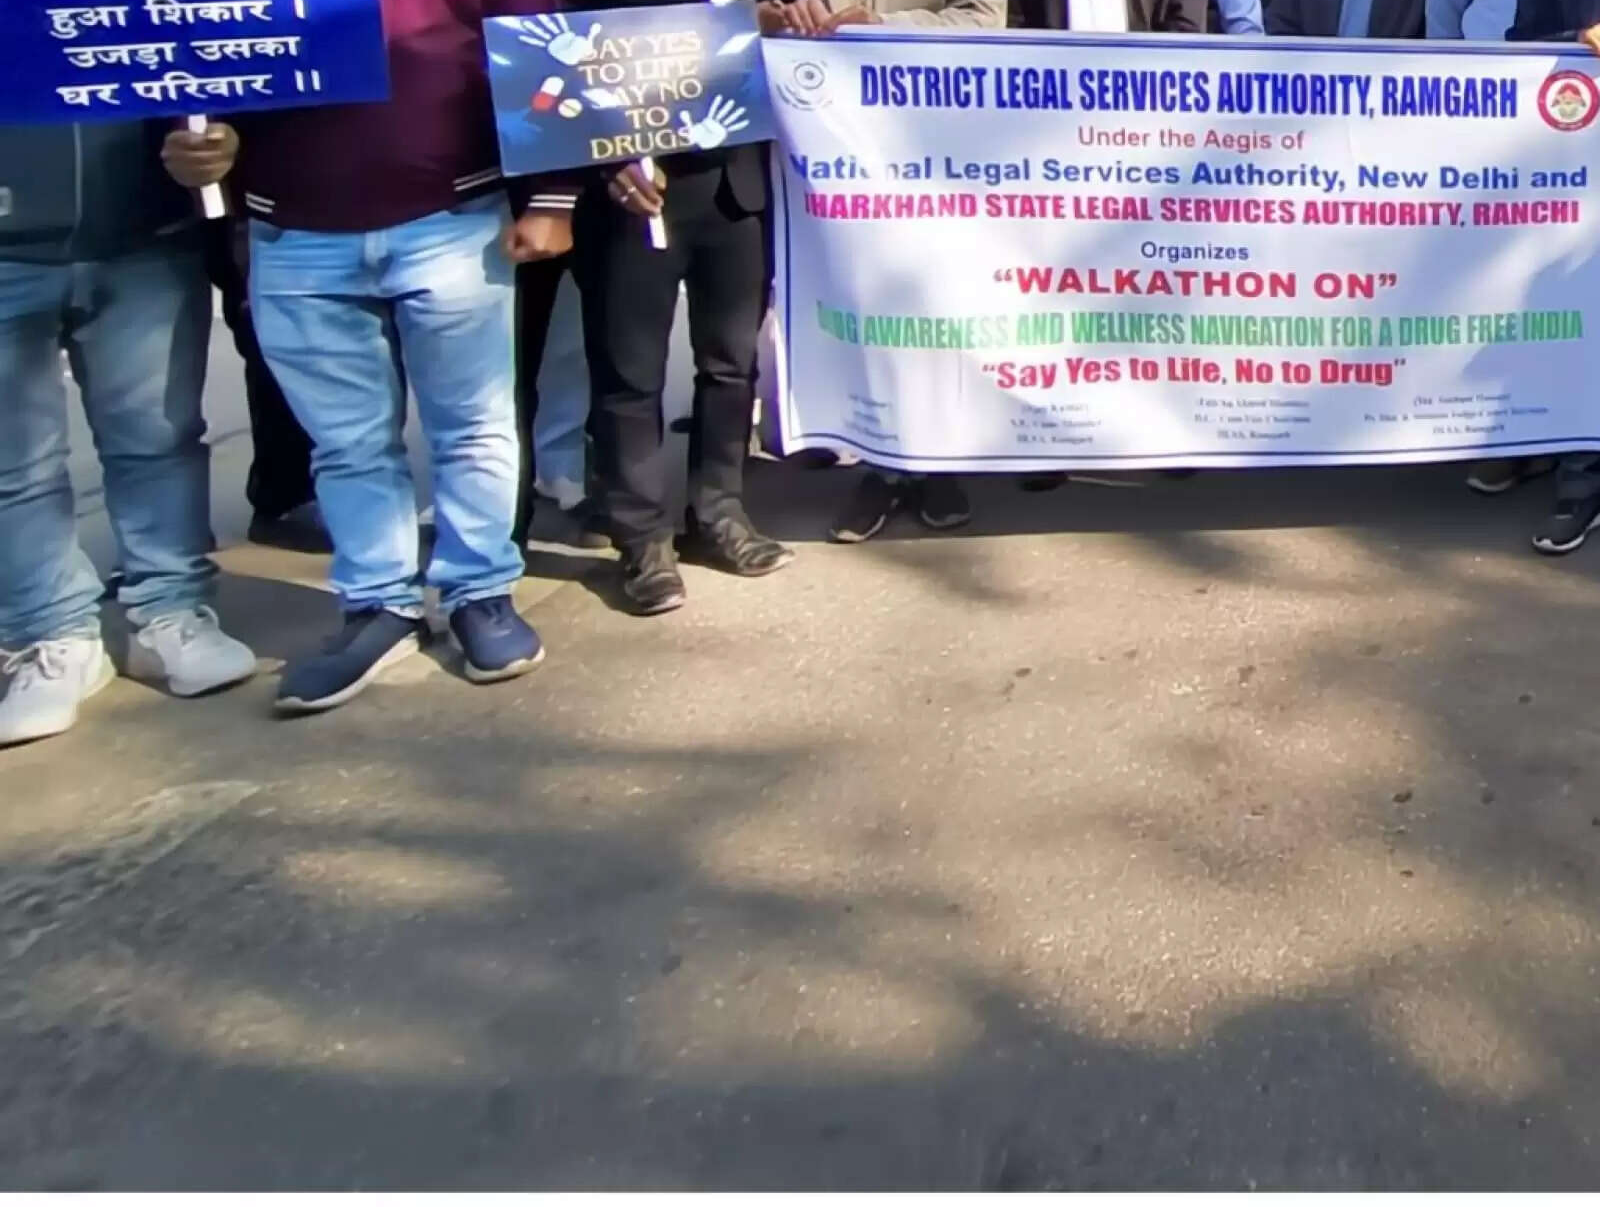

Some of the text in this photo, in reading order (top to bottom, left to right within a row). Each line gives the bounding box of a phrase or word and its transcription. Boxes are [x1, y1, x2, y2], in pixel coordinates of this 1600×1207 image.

[46, 6, 129, 39] हुआ
[63, 36, 301, 70] उजड़ा उसका
[645, 31, 700, 55] YES
[56, 83, 120, 106] घर
[131, 71, 273, 102] परिवार
[578, 62, 625, 85] TO
[660, 78, 702, 103] NO
[860, 65, 986, 109] DISTRICT
[995, 67, 1071, 110] LEGAL
[1080, 69, 1209, 113] SERVICES
[1217, 72, 1374, 119] AUTHORITY,
[1382, 75, 1517, 118] RAMGARH
[625, 106, 669, 129] TO
[590, 126, 696, 159] DRUGS
[1078, 126, 1305, 152] Under the Aegis of
[945, 157, 1030, 186] Legal
[1042, 159, 1180, 185] Services
[1191, 162, 1345, 192] Authority,
[1358, 166, 1428, 189] New
[1439, 166, 1519, 189] Delhi
[1530, 166, 1588, 188] and
[985, 195, 1065, 220] STATE
[1073, 196, 1152, 221] LEGAL
[1160, 197, 1295, 224] SERVICES
[1303, 200, 1466, 227] AUTHORITY,
[1473, 200, 1579, 225] RANCHI
[1141, 242, 1249, 263] Organizes
[863, 312, 1009, 350] AWARENESS
[1016, 312, 1064, 345] AND
[1071, 310, 1185, 345] WELLNESS
[1190, 314, 1325, 347] NAVIGATION
[1331, 317, 1372, 347] FOR
[1379, 317, 1393, 347] A
[1400, 314, 1460, 347] DRUG
[1467, 311, 1516, 343] FREE
[1522, 309, 1582, 342] INDIA
[1065, 357, 1121, 384] Yes
[1130, 357, 1160, 381] to
[1167, 358, 1227, 385] Life,
[1236, 359, 1273, 384] No
[1282, 361, 1311, 384] to
